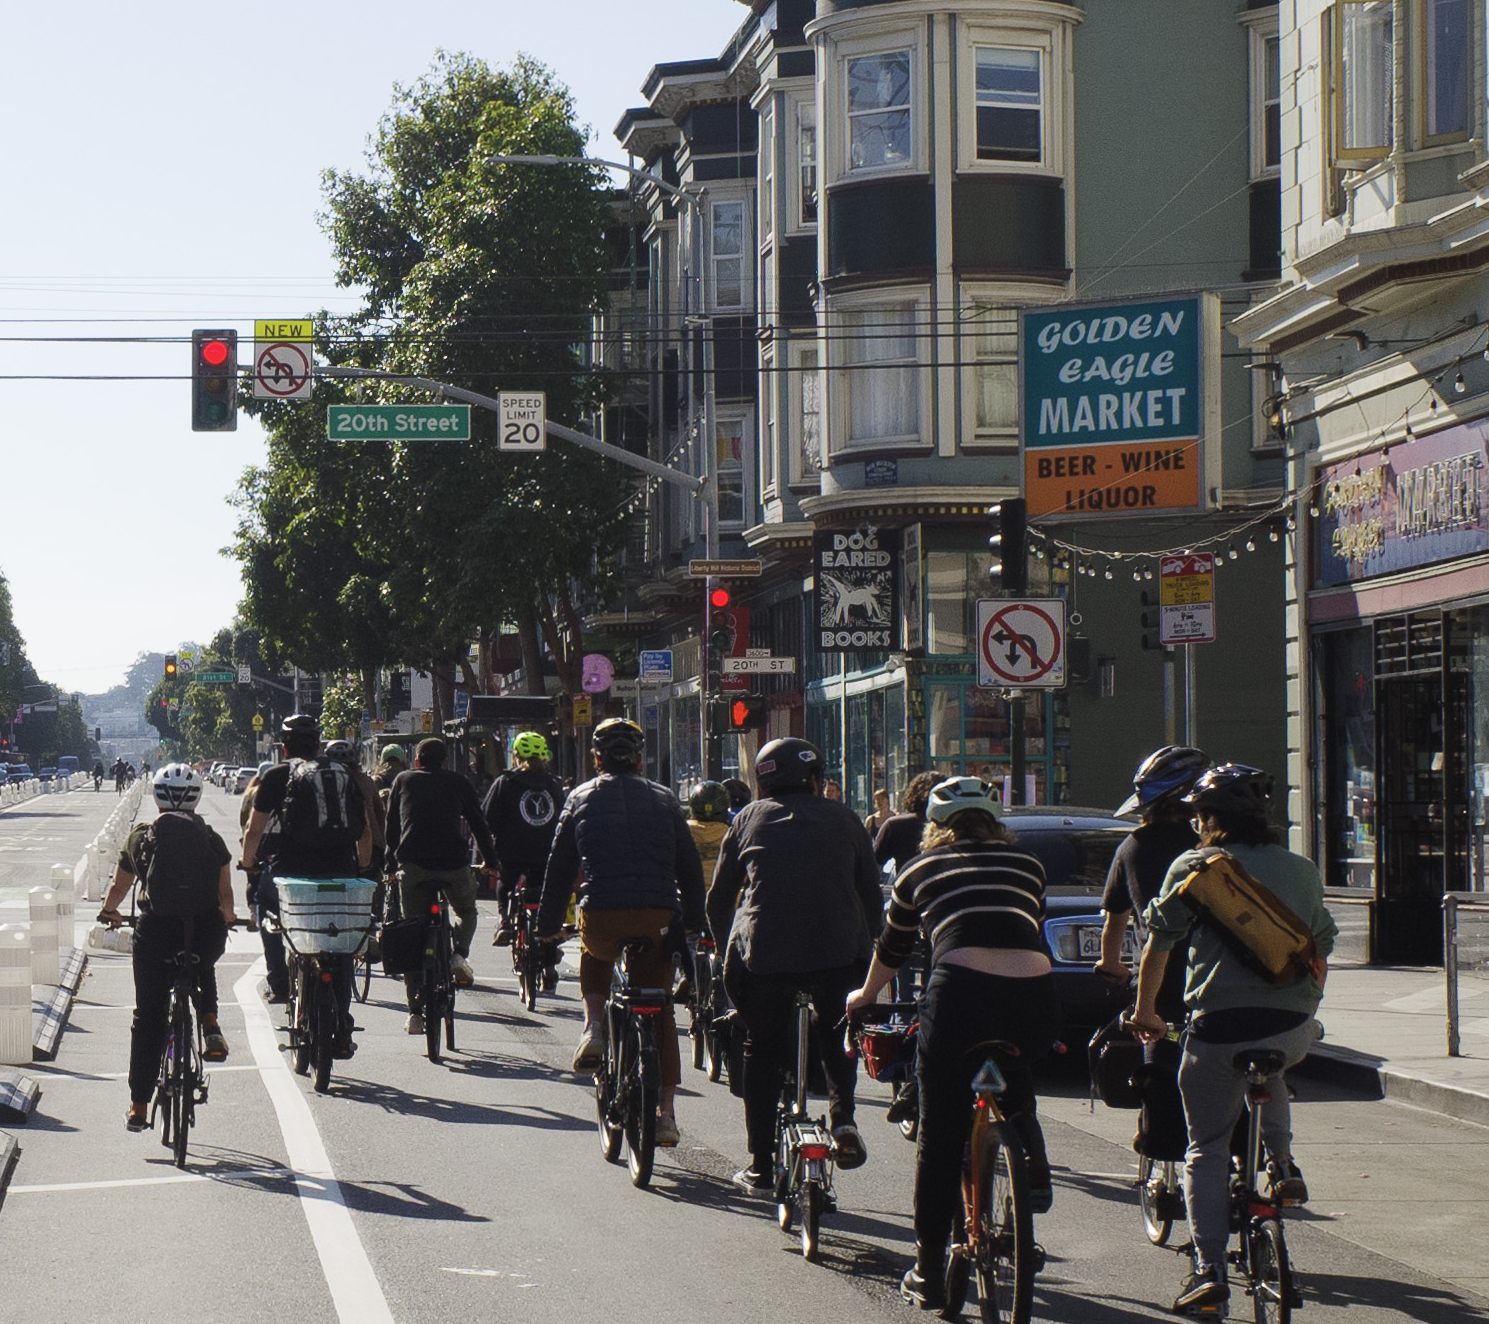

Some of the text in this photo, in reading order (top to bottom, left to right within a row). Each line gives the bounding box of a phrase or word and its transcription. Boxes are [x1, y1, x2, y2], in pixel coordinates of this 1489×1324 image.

[264, 324, 303, 338] NEW
[1037, 310, 1185, 354] GOLDEN
[1058, 350, 1175, 386] EAGLE
[502, 398, 542, 409] SPEED
[1038, 387, 1186, 435] MARKET
[336, 413, 460, 433] 20th Street
[506, 410, 537, 420] LIMIT
[503, 423, 541, 444] 20
[1038, 455, 1097, 479] BEER
[1121, 448, 1186, 473] WINE
[1065, 485, 1157, 511] LIQUOR
[833, 532, 879, 551] DOG
[822, 551, 891, 567] EARED
[821, 631, 891, 647] BOOKS
[733, 660, 785, 670] 20TH ST
